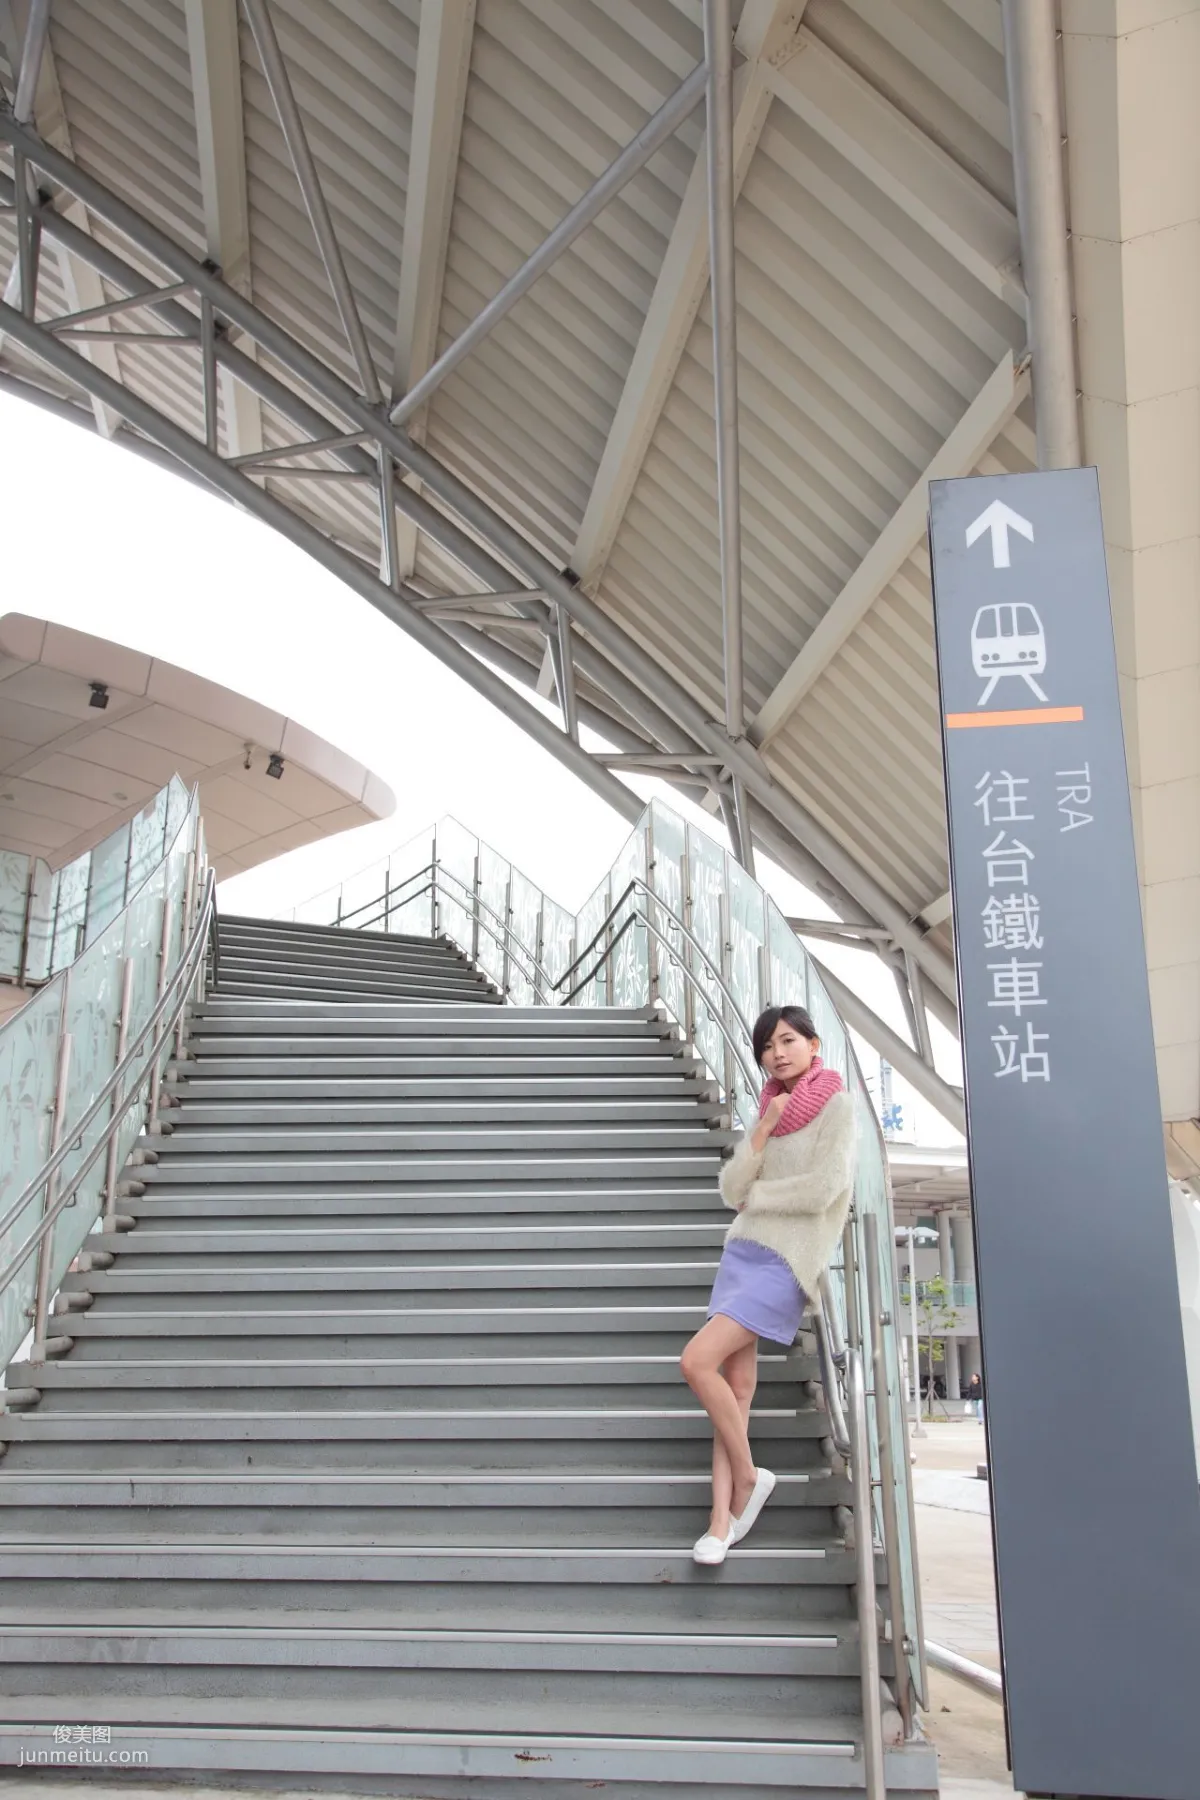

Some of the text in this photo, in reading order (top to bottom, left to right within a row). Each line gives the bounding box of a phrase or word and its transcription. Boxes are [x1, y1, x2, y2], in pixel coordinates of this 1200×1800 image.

[1055, 762, 1094, 833] TRA
[973, 770, 1051, 1082] 往台鐵車站
